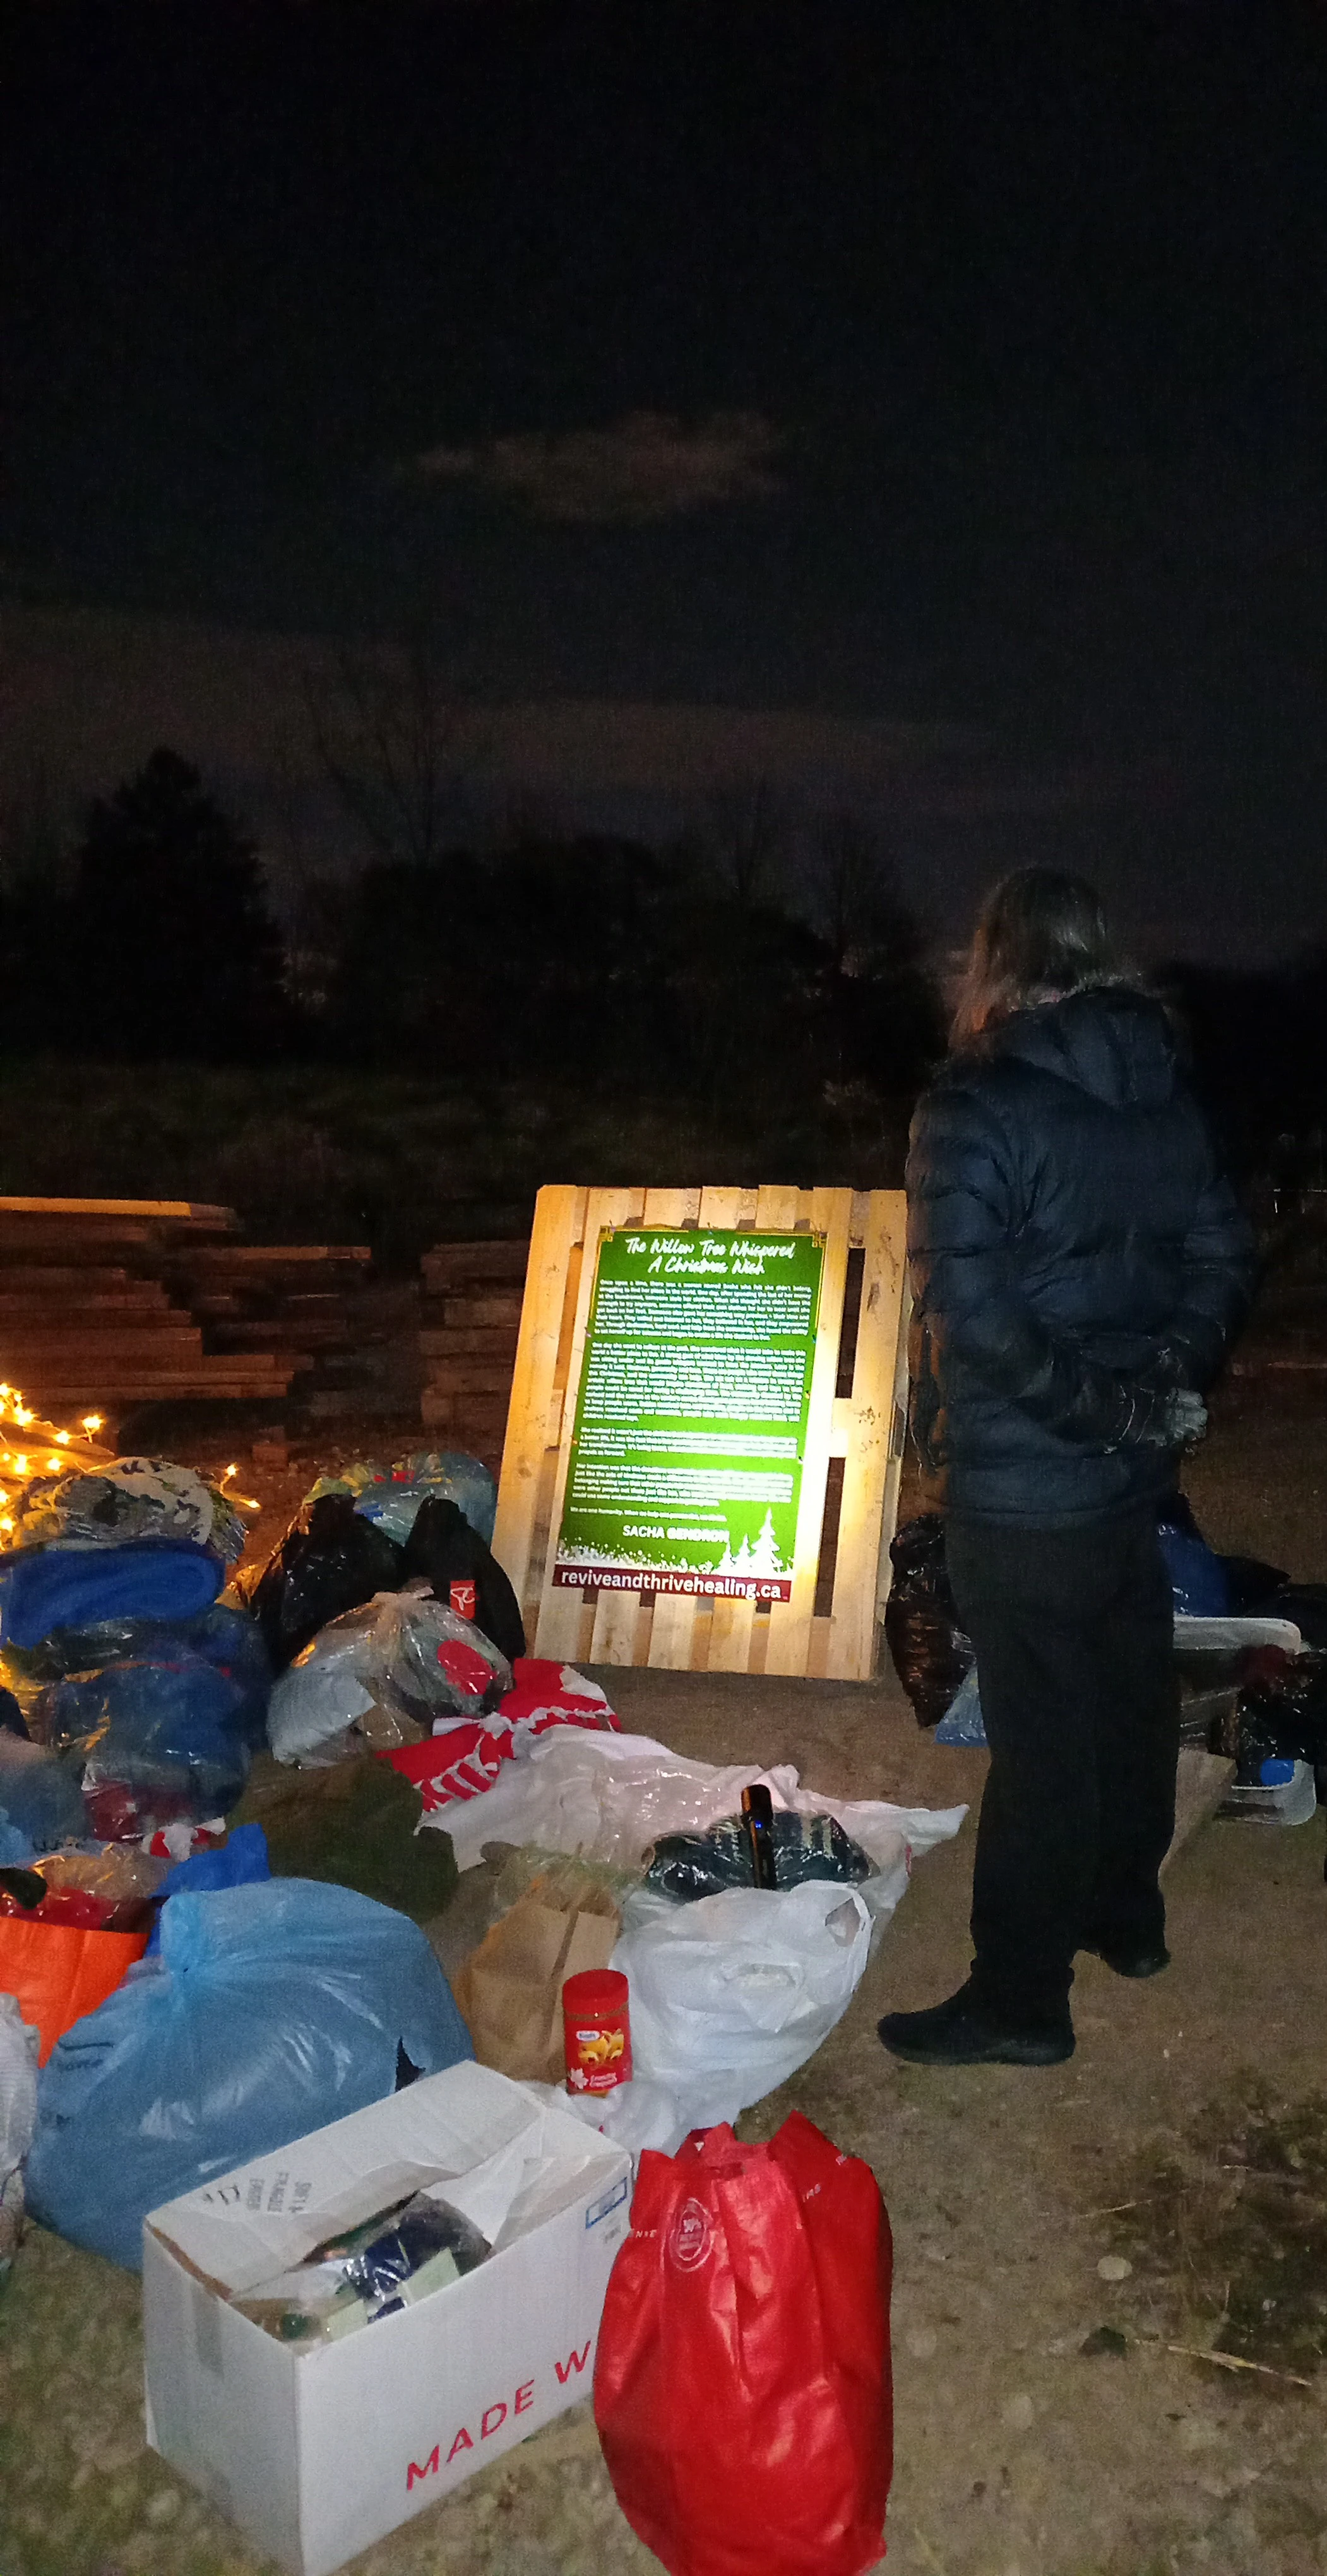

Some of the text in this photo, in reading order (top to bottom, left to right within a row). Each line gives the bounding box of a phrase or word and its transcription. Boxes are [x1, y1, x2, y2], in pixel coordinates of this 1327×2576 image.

[625, 1237, 796, 1260] The Willow Tree Whispered
[648, 1255, 765, 1275] A Christmas Wish
[622, 1525, 665, 1539] SACHA
[561, 1570, 781, 1600] reviveandthrivehealing.ca
[407, 2379, 535, 2491] MADE
